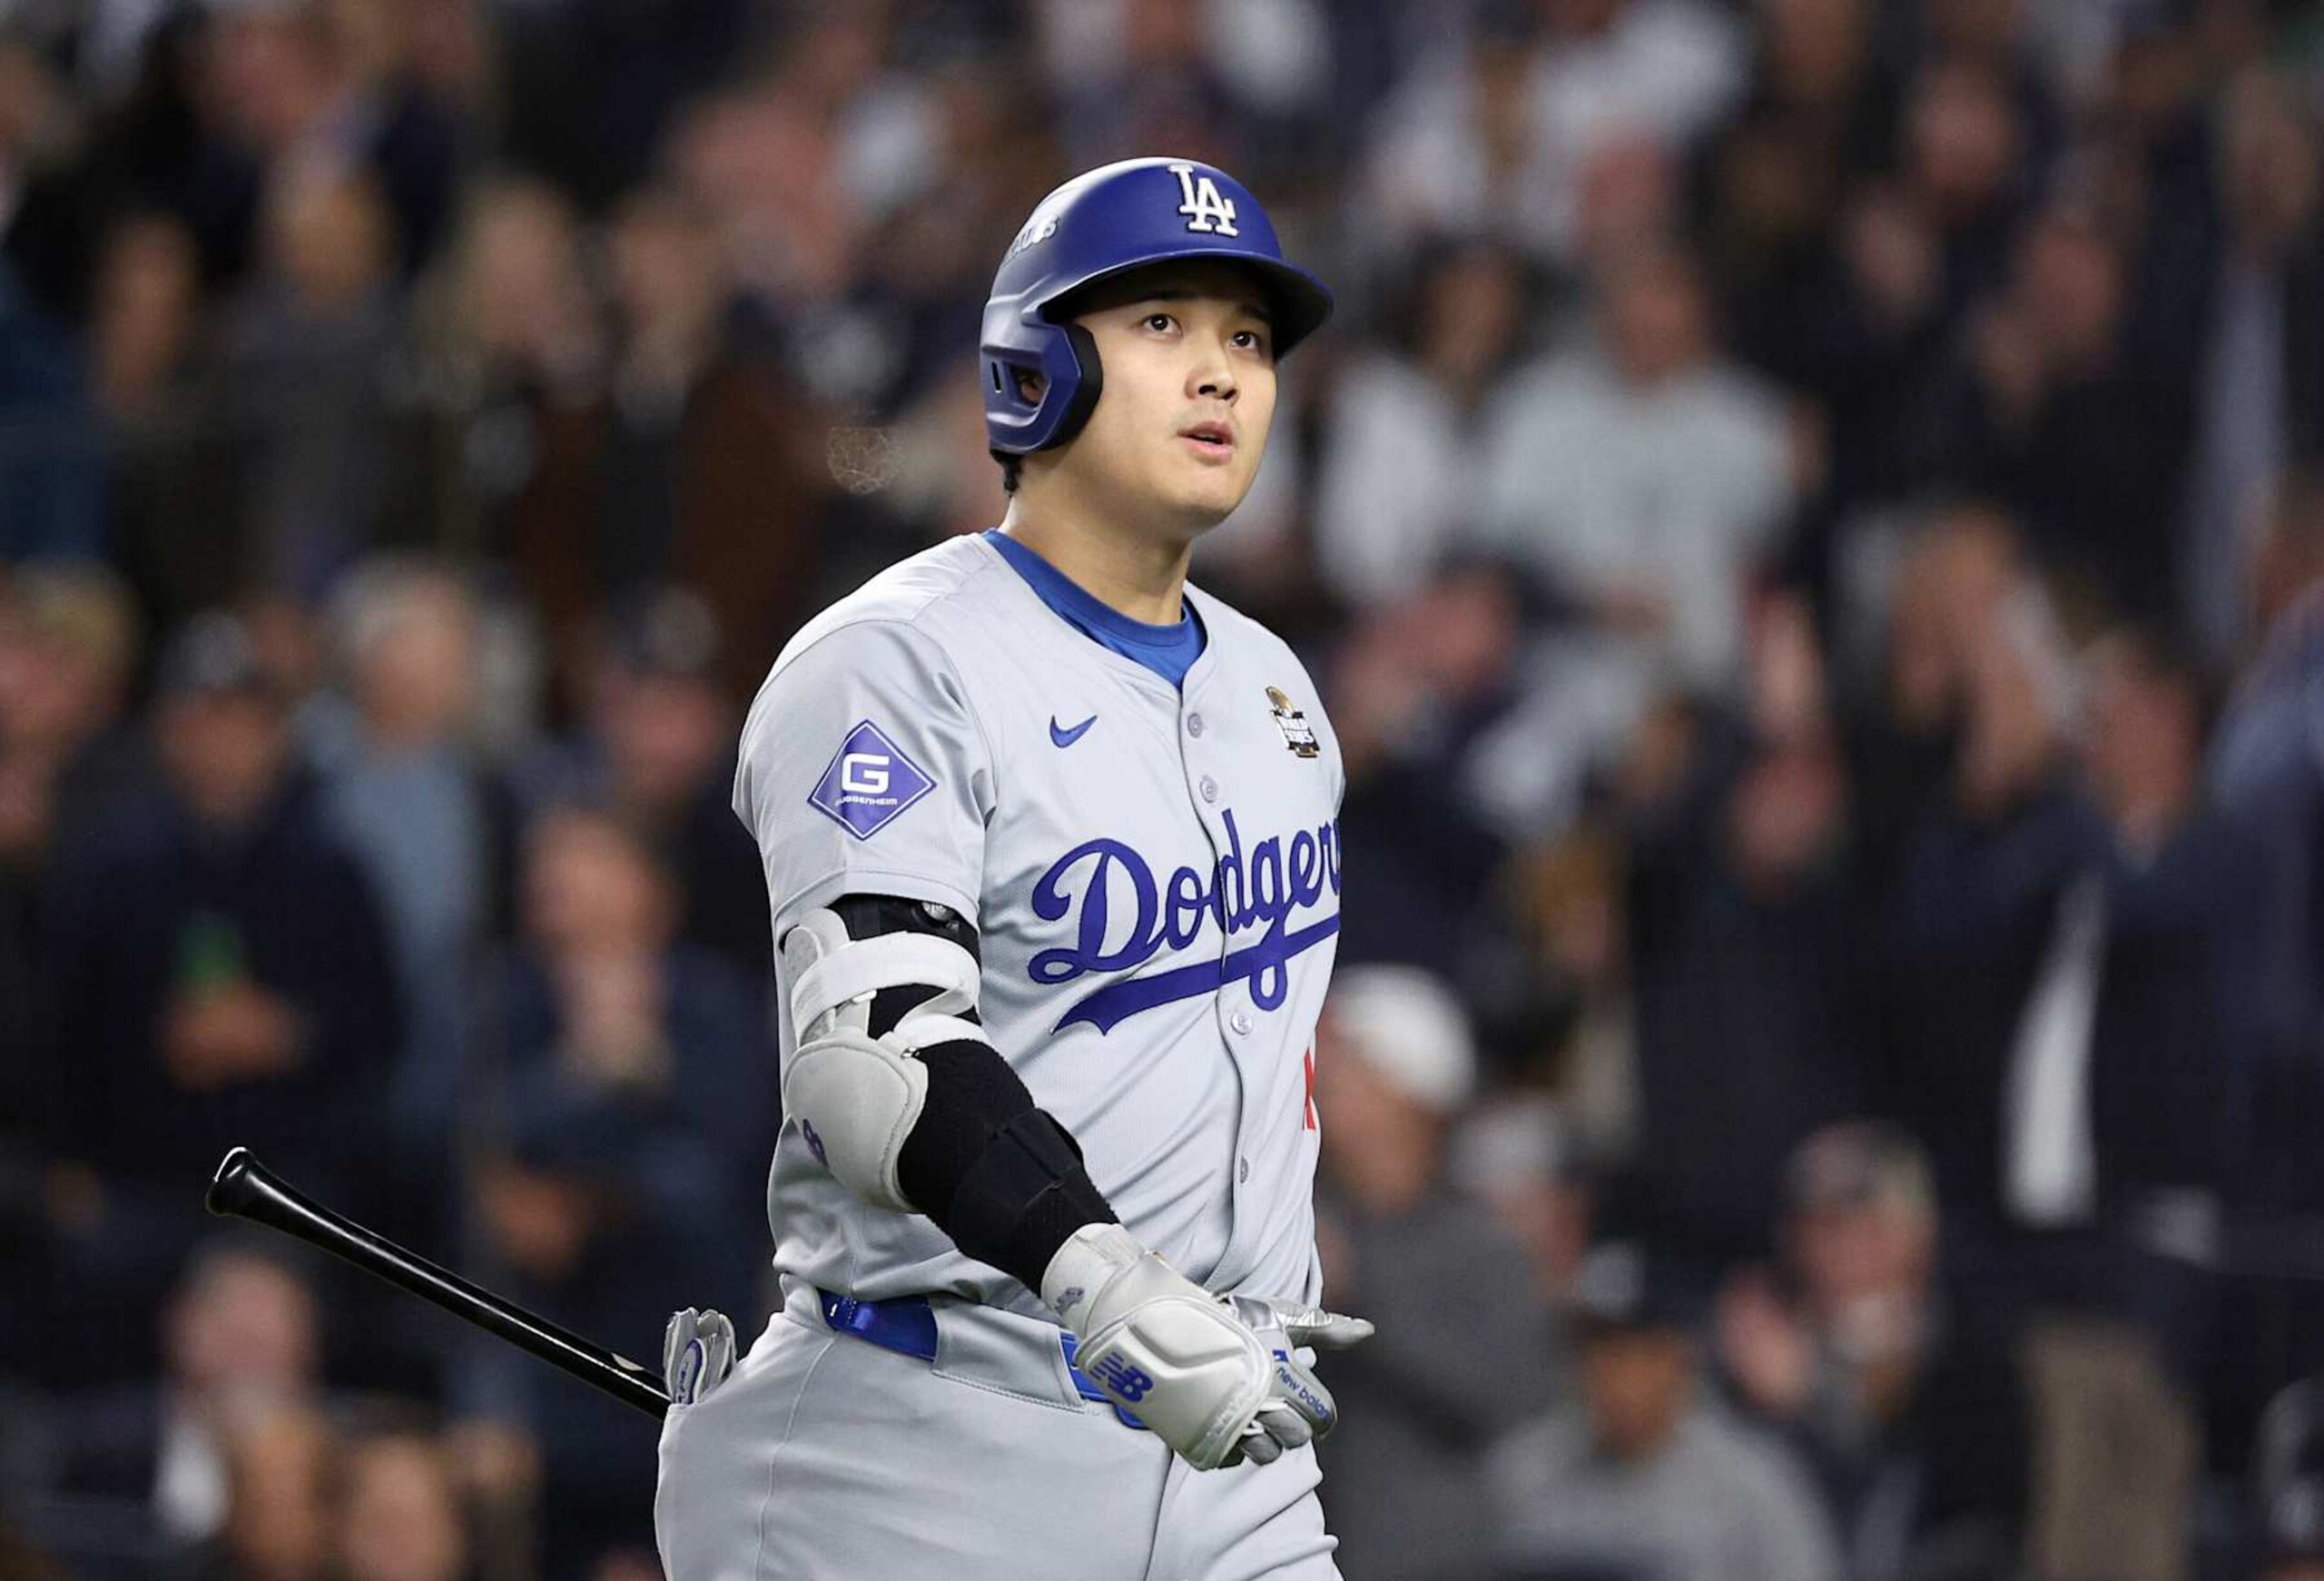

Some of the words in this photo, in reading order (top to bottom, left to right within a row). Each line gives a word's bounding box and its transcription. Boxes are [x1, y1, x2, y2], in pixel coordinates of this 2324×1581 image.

[1167, 164, 1239, 237] LA
[842, 753, 890, 794] G
[1028, 808, 1340, 1012] Dodger
[1276, 1366, 1300, 1391] new
